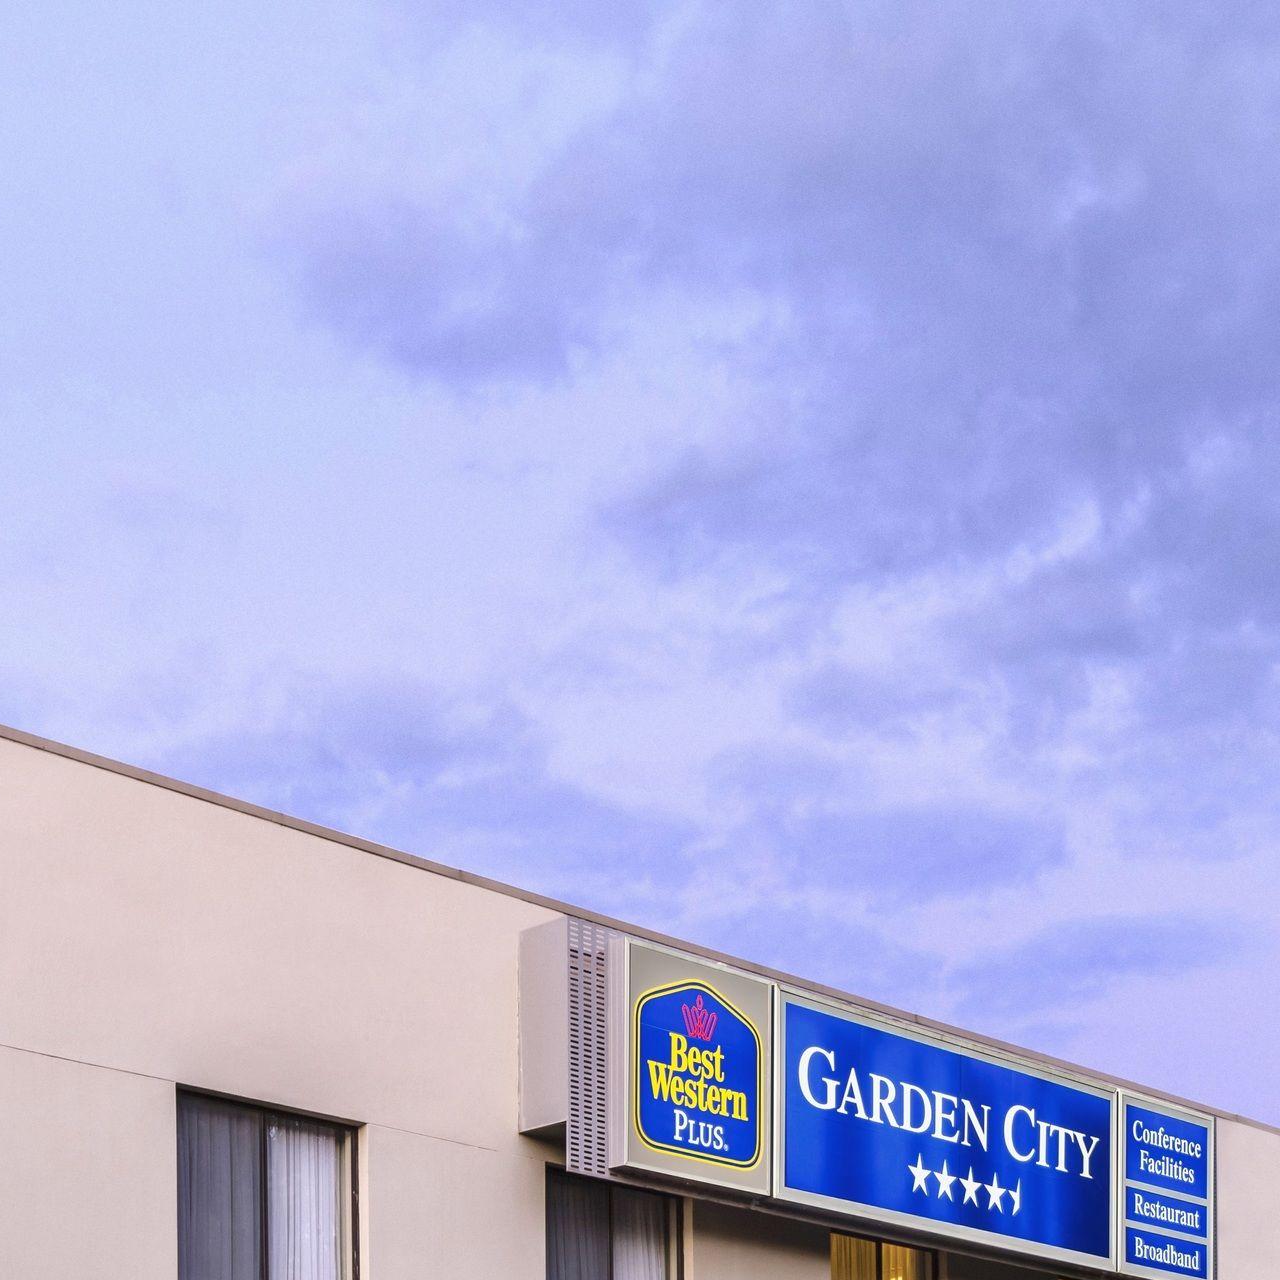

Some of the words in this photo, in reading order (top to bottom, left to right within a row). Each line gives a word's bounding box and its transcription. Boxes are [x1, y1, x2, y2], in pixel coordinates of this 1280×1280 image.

[668, 1032, 725, 1083] Best
[646, 1059, 749, 1122] Western
[798, 1046, 992, 1152] GARDEN
[1003, 1104, 1100, 1179] CITY
[1132, 1120, 1202, 1158] Conference
[1139, 1150, 1195, 1184] Facilities
[1134, 1193, 1200, 1229] Restaurant
[1134, 1236, 1200, 1270] Broadband
